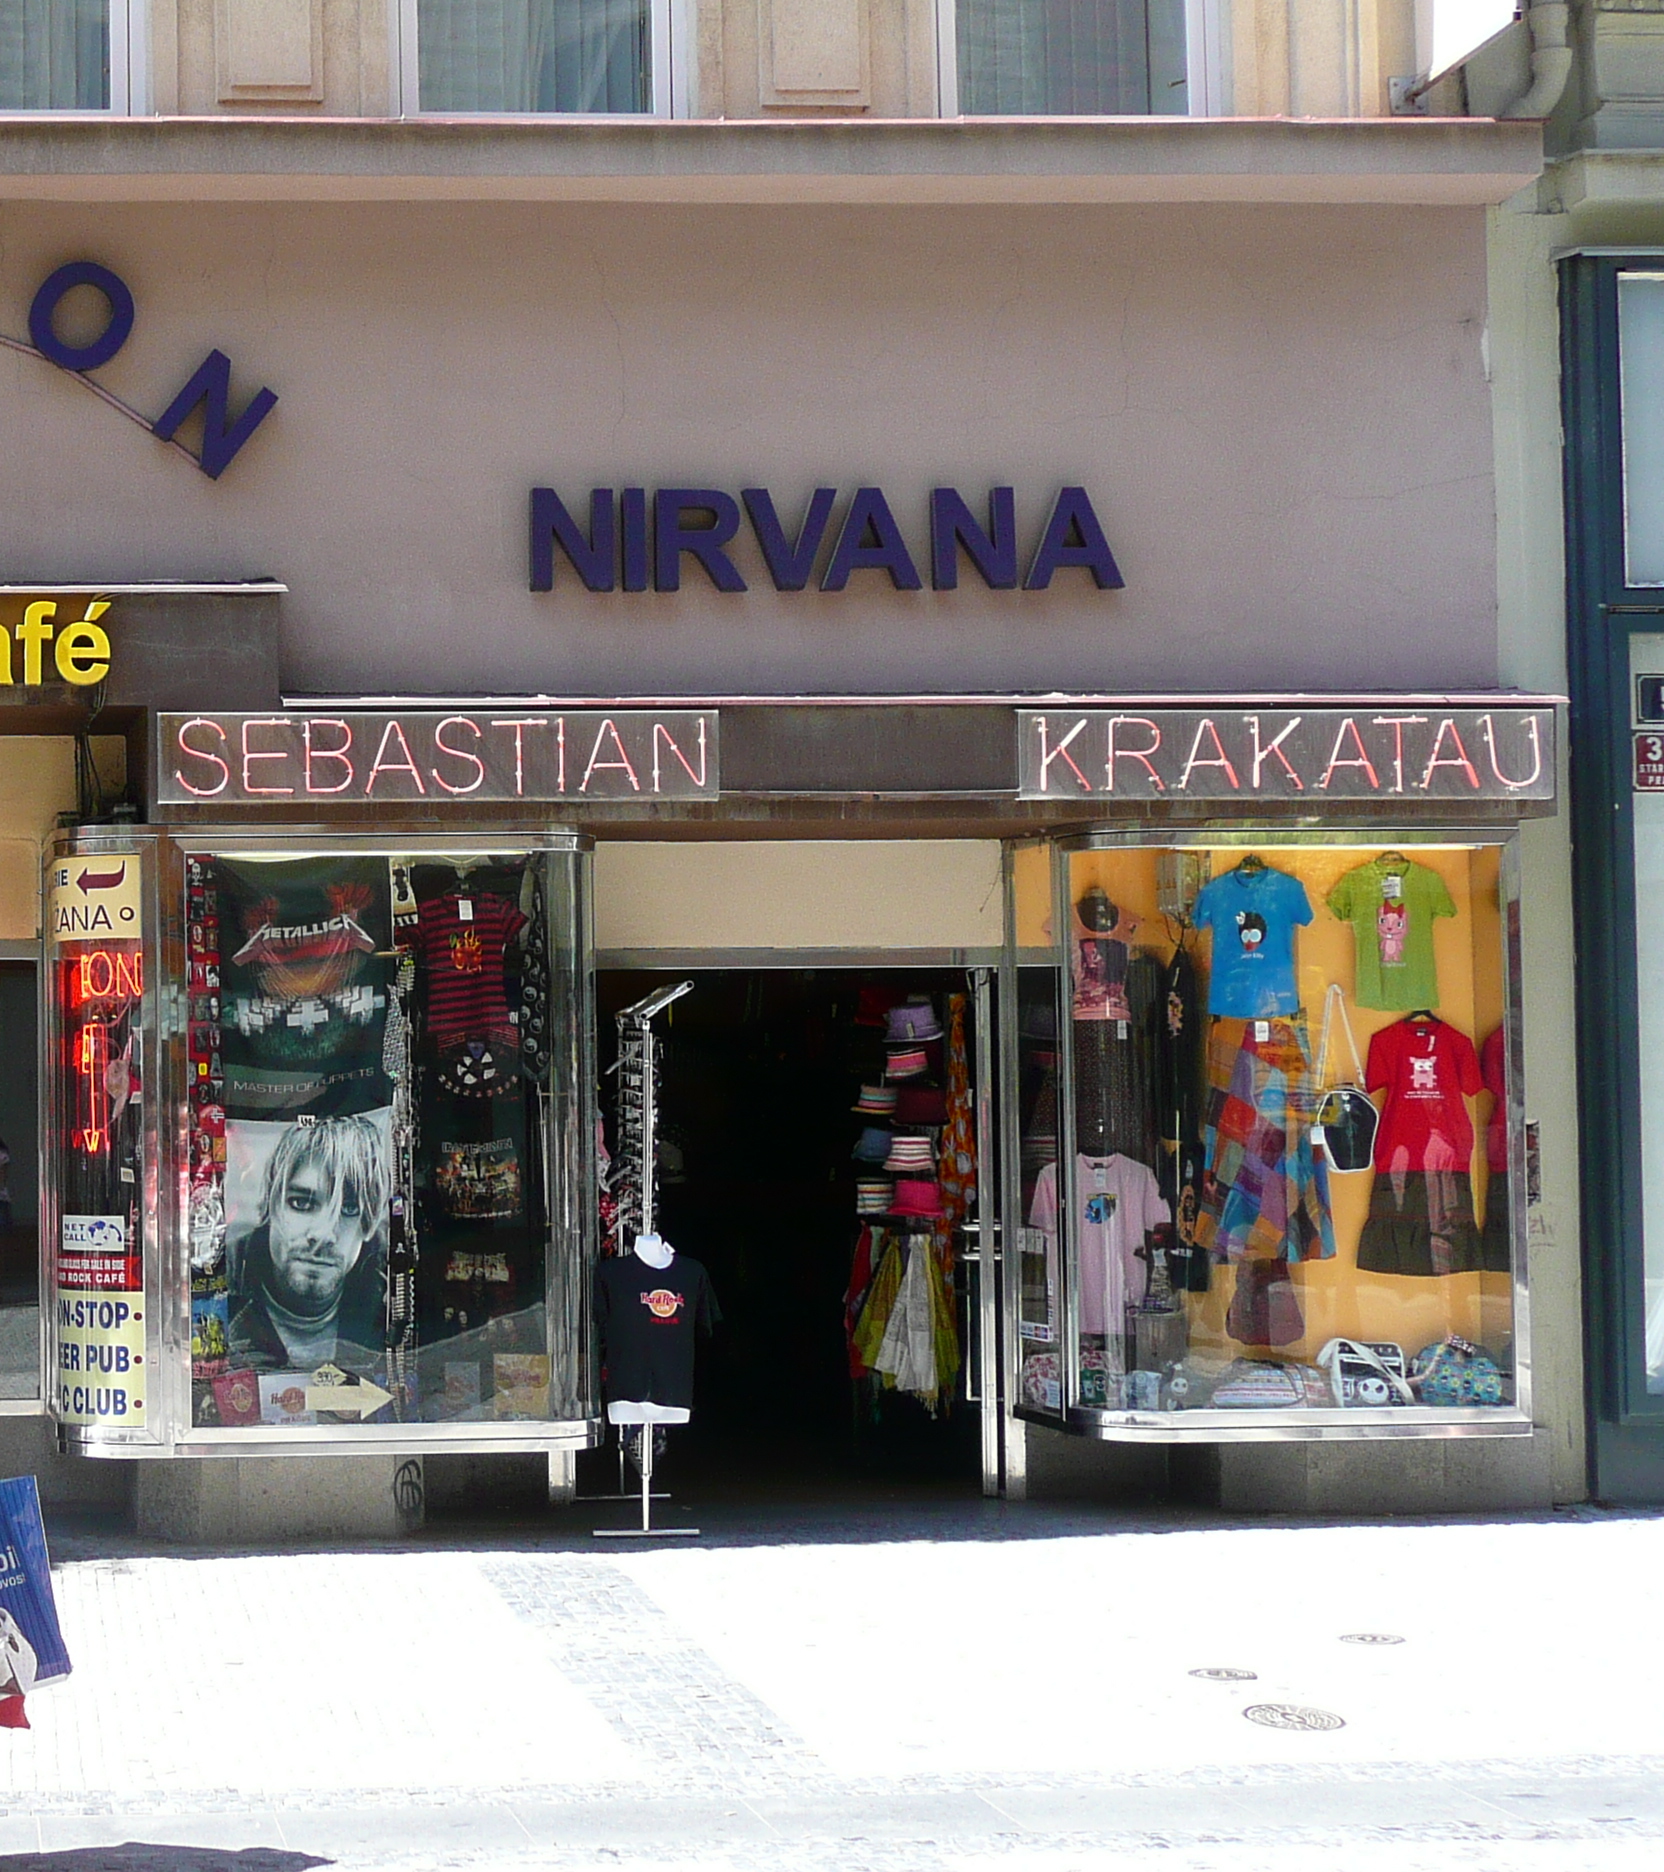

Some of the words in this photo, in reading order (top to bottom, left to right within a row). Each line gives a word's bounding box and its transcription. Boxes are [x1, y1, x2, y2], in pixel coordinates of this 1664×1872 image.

[529, 486, 1125, 592] NIRVANA
[175, 716, 707, 797] SEBASTIAN
[1036, 714, 1543, 793] KRAKATAU
[233, 1080, 295, 1094] MASTER
[63, 1233, 86, 1241] CALL
[64, 1223, 86, 1231] NET
[67, 1272, 92, 1283] ROCK
[95, 1271, 126, 1284] CAFÉ
[86, 1344, 130, 1373] PUB
[73, 1385, 127, 1415] CLUB
